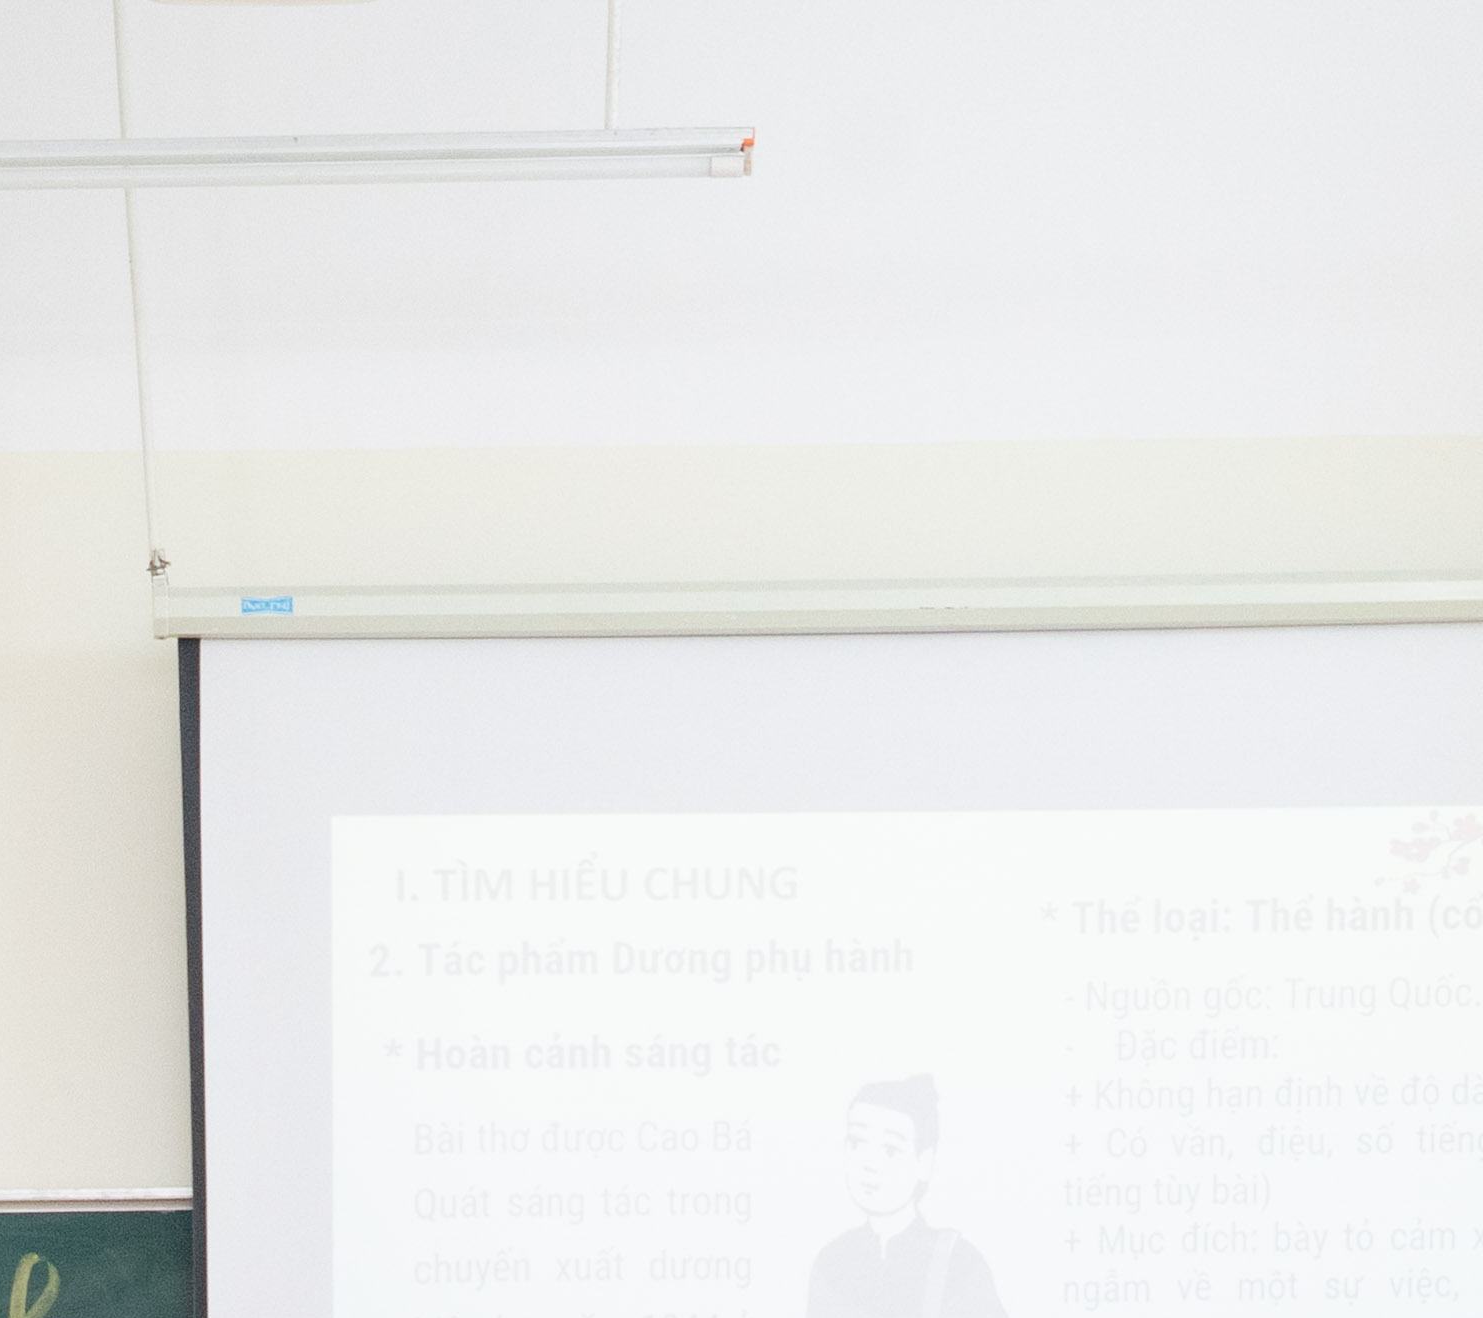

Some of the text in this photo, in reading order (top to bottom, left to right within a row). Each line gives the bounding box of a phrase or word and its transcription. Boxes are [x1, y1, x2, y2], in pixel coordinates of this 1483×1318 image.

[397, 853, 797, 902] I. TÌM HIỂU CHUNG
[1072, 897, 1140, 934] Thể
[1154, 899, 1230, 941] loại:
[1245, 894, 1313, 932] Thể
[1327, 895, 1418, 931] hành
[1428, 892, 1483, 939] (cổ
[370, 938, 912, 985] 2. Tác phẩm Dương phụ hành
[1087, 973, 1480, 1019] Nguồn gốc: Trung Quốc.
[417, 1033, 780, 1077] Hoàn cảnh sáng tác
[1116, 1025, 1278, 1065] Đặc điểm:
[1096, 1079, 1194, 1117] Không
[1208, 1077, 1262, 1112] hạn
[1275, 1076, 1342, 1113] định
[1355, 1077, 1388, 1106] về
[1401, 1074, 1439, 1110] độ
[415, 1120, 751, 1158] Bài thơ được Cao Bá
[1107, 1128, 1147, 1158] Có
[1172, 1128, 1233, 1160] vần,
[1258, 1125, 1332, 1161] điệu,
[1358, 1121, 1393, 1154] số
[415, 1185, 751, 1225] Quát sáng tác trong
[1064, 1173, 1270, 1214] tiếng tùy bài)
[1099, 1225, 1164, 1260] Mục
[1182, 1222, 1256, 1253] đích:
[1275, 1221, 1328, 1260] bày
[1344, 1219, 1374, 1251] tỏ
[1390, 1218, 1455, 1251] cảm
[414, 1250, 751, 1291] chuyến xuất dương
[1064, 1269, 1150, 1311] ngẫm
[1178, 1272, 1211, 1301] về
[1239, 1270, 1297, 1303] một
[1325, 1276, 1364, 1305] sự
[1389, 1268, 1459, 1303] việc,
